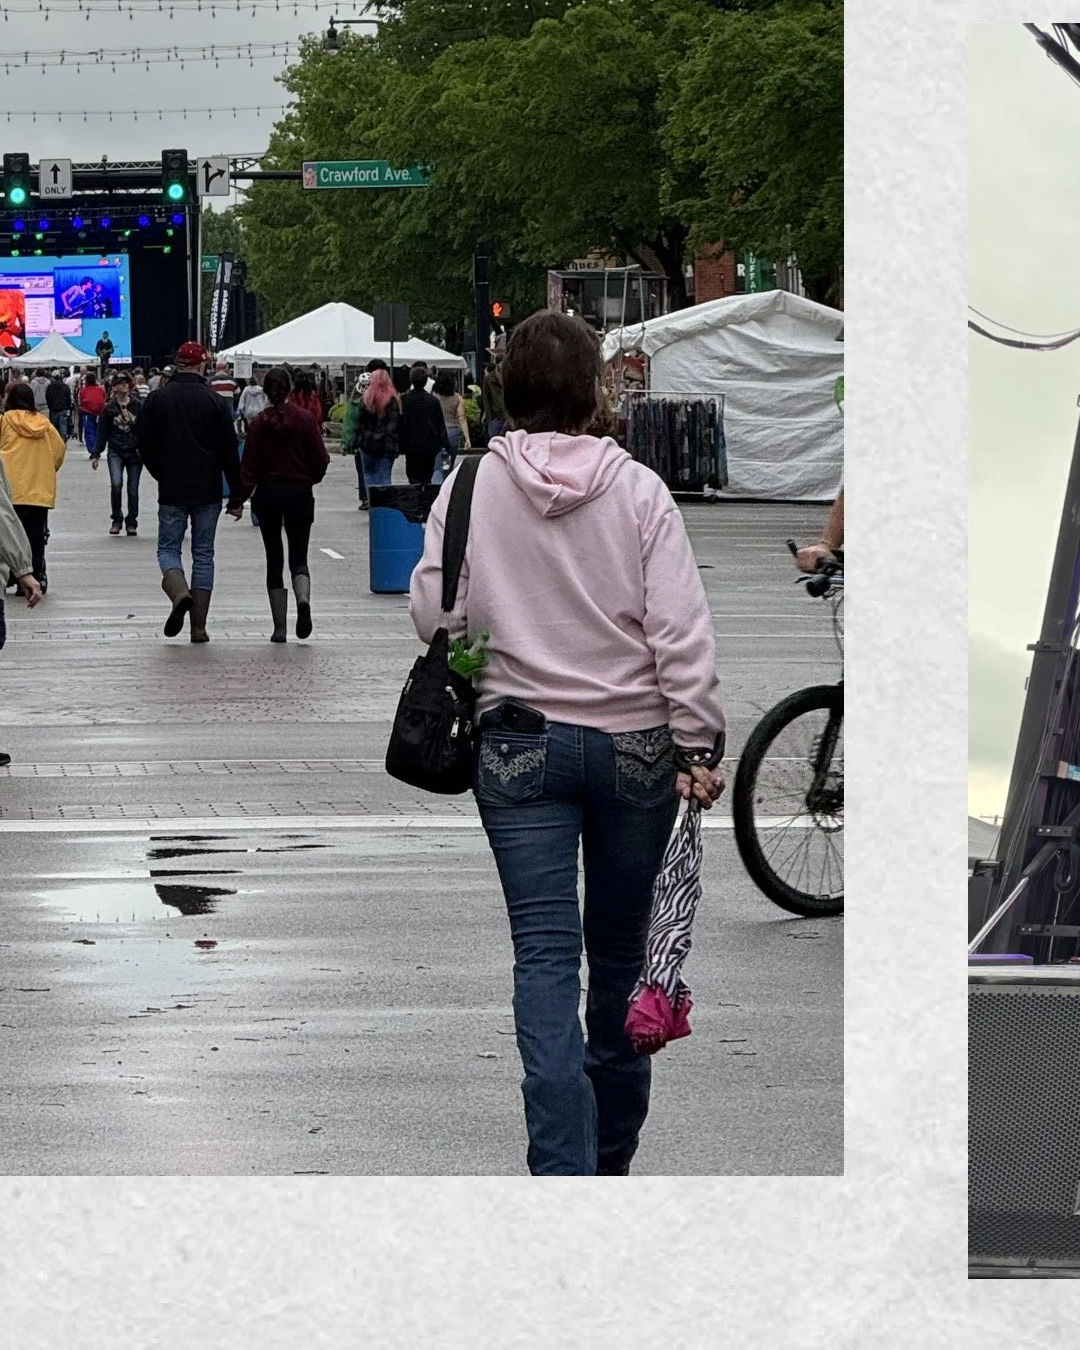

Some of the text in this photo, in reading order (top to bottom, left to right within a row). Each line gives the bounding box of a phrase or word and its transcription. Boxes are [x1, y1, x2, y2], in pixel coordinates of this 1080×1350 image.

[320, 166, 412, 183] Crawford Ave.
[44, 186, 67, 195] ONLY
